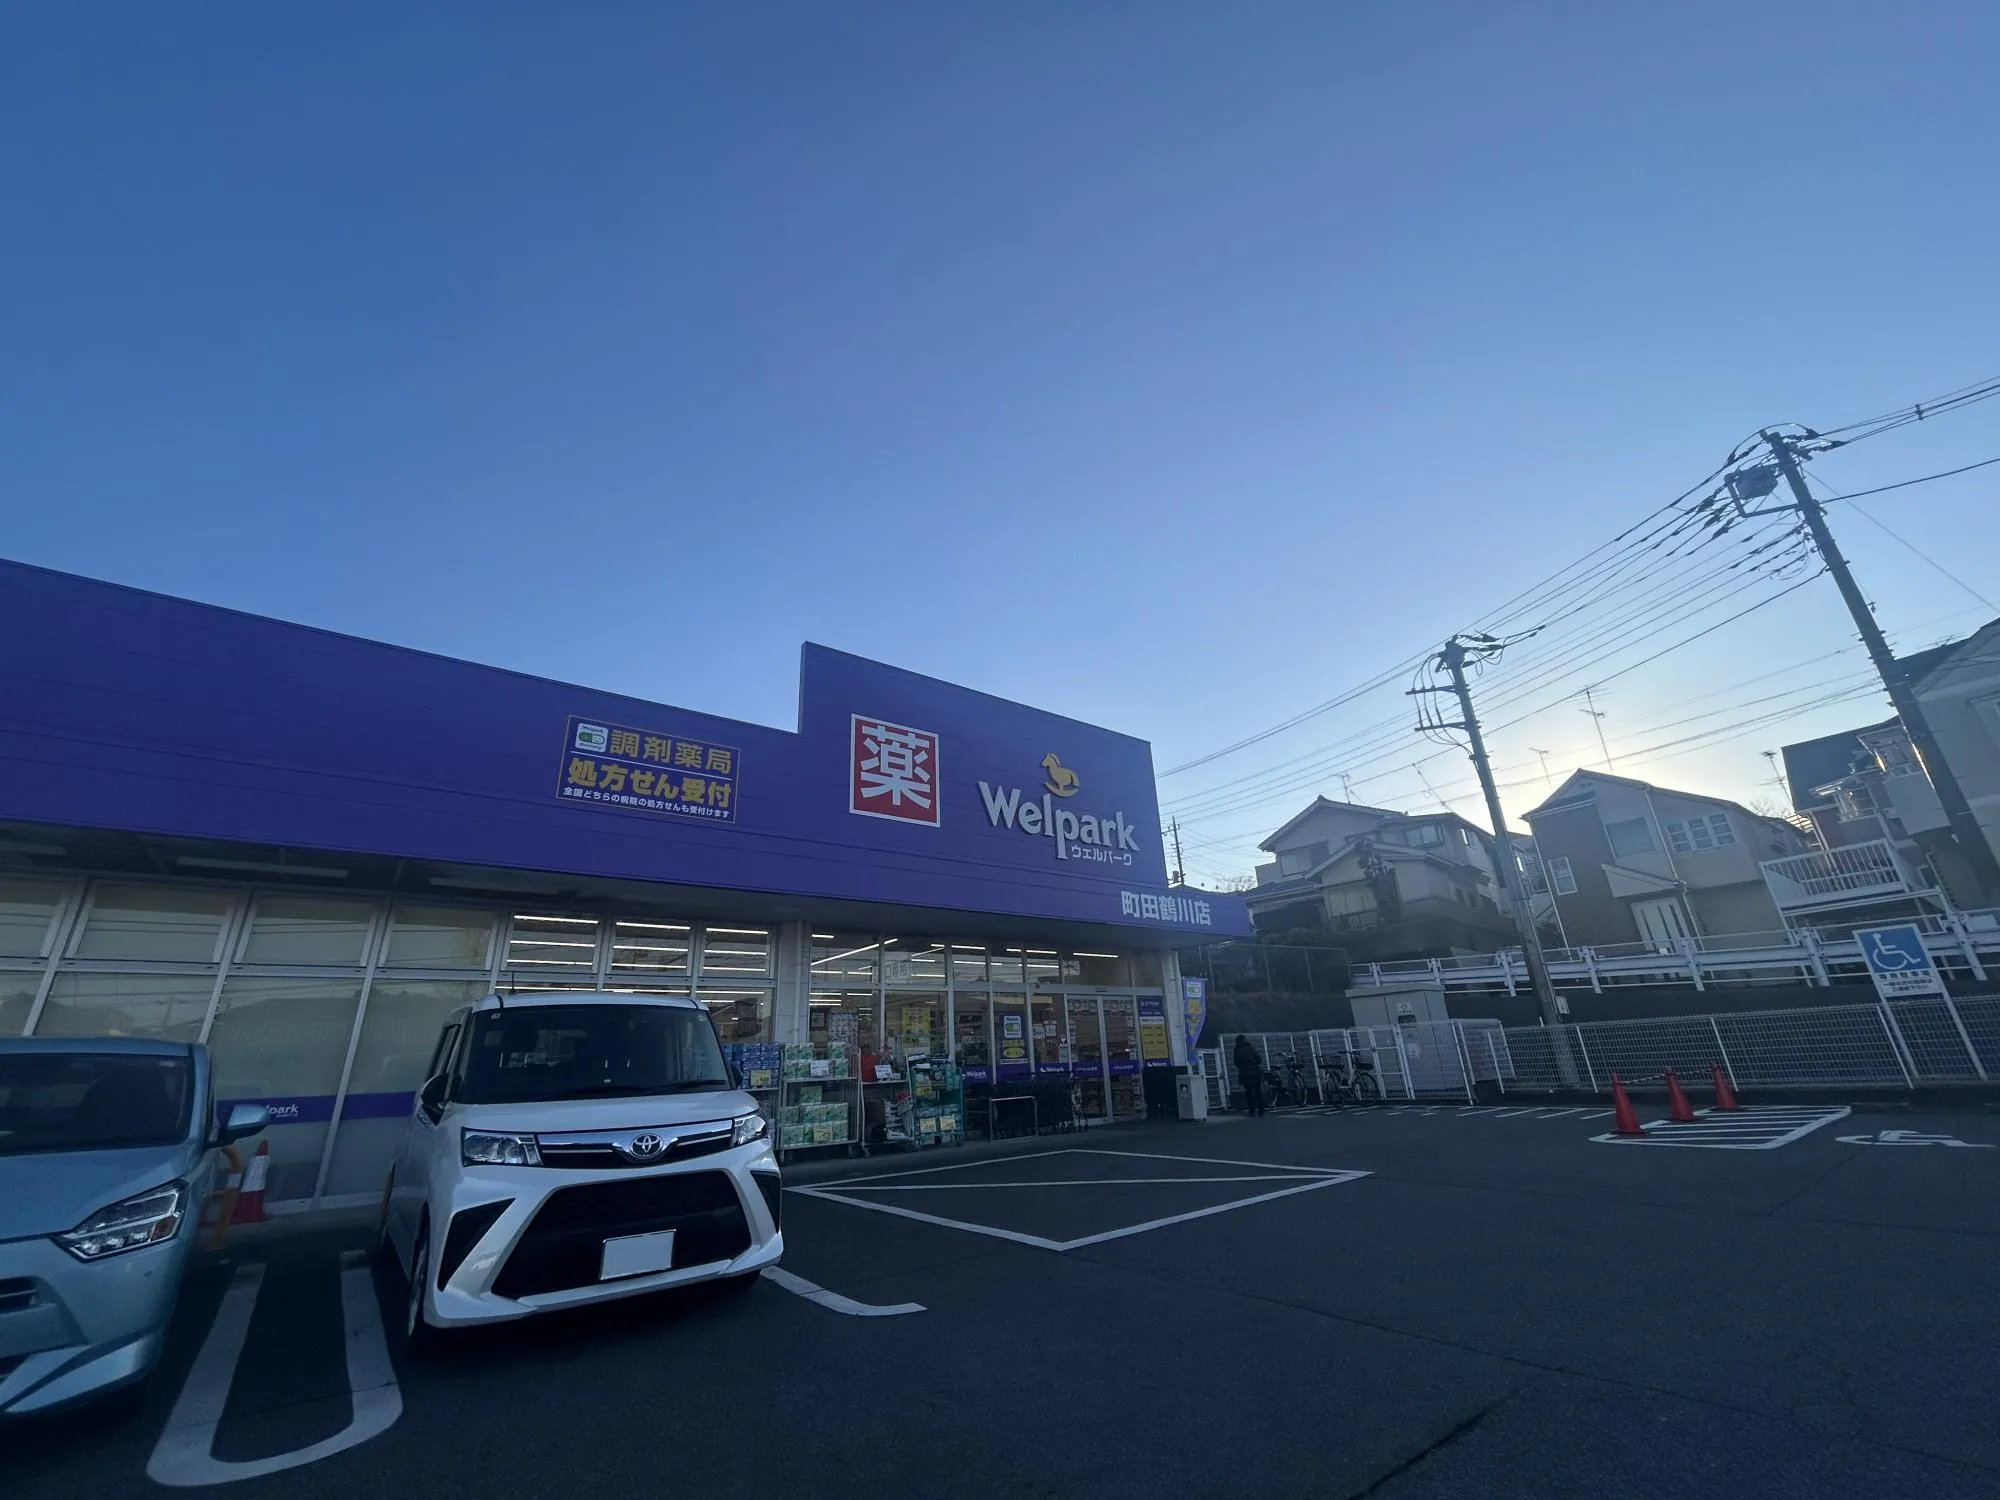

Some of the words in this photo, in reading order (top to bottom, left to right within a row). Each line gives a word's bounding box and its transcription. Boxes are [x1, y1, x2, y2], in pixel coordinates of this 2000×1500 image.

[609, 729, 732, 774] 調剤薬局
[860, 725, 931, 809] 薬
[563, 786, 731, 818] 全国どちらの病院の処方せんも受付けます
[567, 757, 732, 808] 処方せん受付
[977, 780, 1141, 860] Welpark
[1120, 890, 1212, 927] 町田鶴川店
